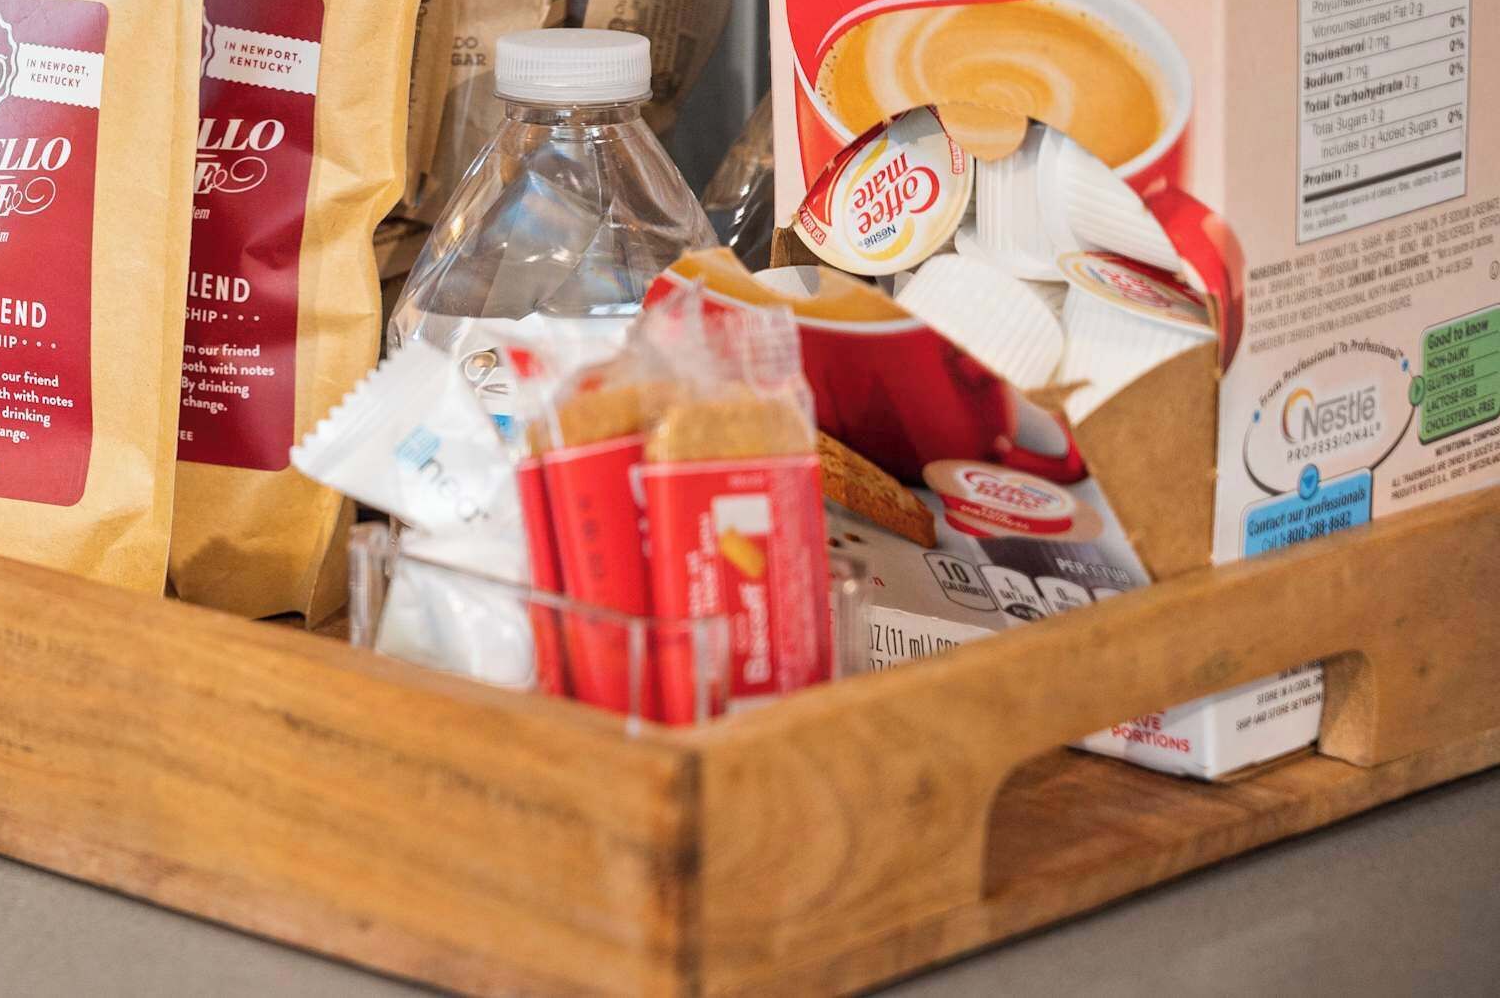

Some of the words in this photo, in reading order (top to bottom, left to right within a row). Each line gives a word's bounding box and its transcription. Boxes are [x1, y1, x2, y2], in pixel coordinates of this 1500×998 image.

[224, 41, 236, 51] IN
[241, 42, 302, 64] NEWPORT,
[452, 52, 487, 67] GAR
[26, 58, 37, 69] IN
[40, 60, 90, 77] NEWPORT,
[229, 56, 293, 74] KENTUCKY
[30, 73, 81, 88] KENTUCKY
[1304, 70, 1343, 91] Sodium
[1304, 96, 1330, 114] Total
[1334, 79, 1403, 108] Carbohydrate
[853, 152, 909, 209] mate
[1303, 168, 1342, 189] Protein
[857, 166, 940, 235] Coffee
[190, 271, 251, 303] LEND
[1428, 327, 1450, 350] Good
[1453, 327, 1463, 342] to
[1465, 319, 1488, 337] know
[198, 346, 218, 356] our
[222, 344, 260, 358] friend
[1427, 346, 1470, 369] NON-DAIRY
[2, 372, 21, 383] our
[24, 371, 59, 387] friend
[182, 361, 207, 374] ooth
[210, 363, 238, 376] with
[240, 366, 275, 377] notes
[1259, 380, 1282, 408] From
[1283, 342, 1336, 380] Professional
[1350, 338, 1400, 360] Professional
[1427, 364, 1475, 392] GLUTEN-FREE
[13, 389, 39, 404] with
[42, 395, 74, 408] notes
[181, 377, 196, 393] By
[198, 377, 250, 400] drinking
[1426, 384, 1477, 413] LACTOSE-FREE
[2, 406, 51, 428] drinking
[183, 397, 228, 415] change.
[1302, 386, 1376, 441] Nestlé
[1286, 425, 1375, 463] PROFESSIONAL
[1247, 513, 1285, 537] Contact
[1287, 509, 1304, 523] our
[1306, 484, 1365, 521] professionals
[938, 559, 971, 584] 10
[1057, 558, 1087, 575] PER
[1111, 724, 1191, 753] PORTIONS
